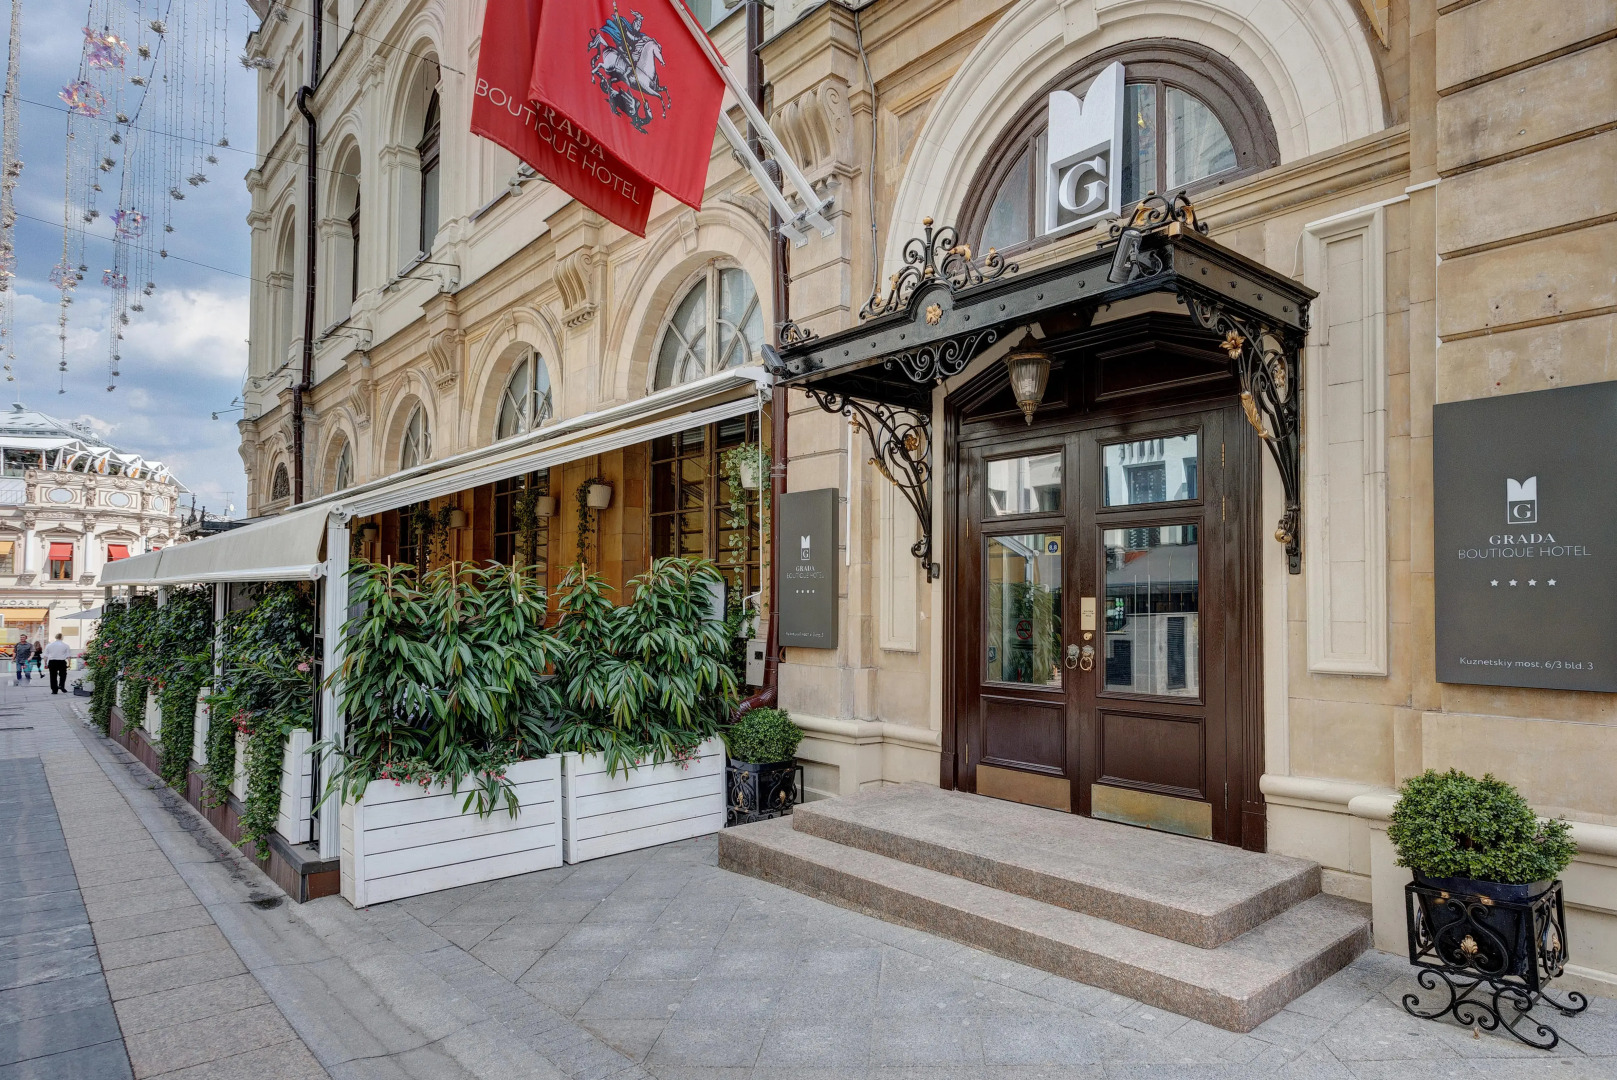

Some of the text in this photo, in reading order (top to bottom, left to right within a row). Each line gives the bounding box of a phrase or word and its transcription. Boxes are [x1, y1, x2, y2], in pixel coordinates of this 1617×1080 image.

[475, 78, 640, 204] BOUTIQUE HOTEL
[1059, 156, 1108, 214] G
[1513, 503, 1532, 519] G
[1489, 533, 1556, 545] GRADA
[802, 549, 809, 558] G
[1458, 545, 1592, 559] BOUTIQUE HOTEL
[1459, 657, 1512, 668] Kuznetskiy
[1545, 660, 1562, 670] 6/3
[1587, 662, 1594, 670] 3
